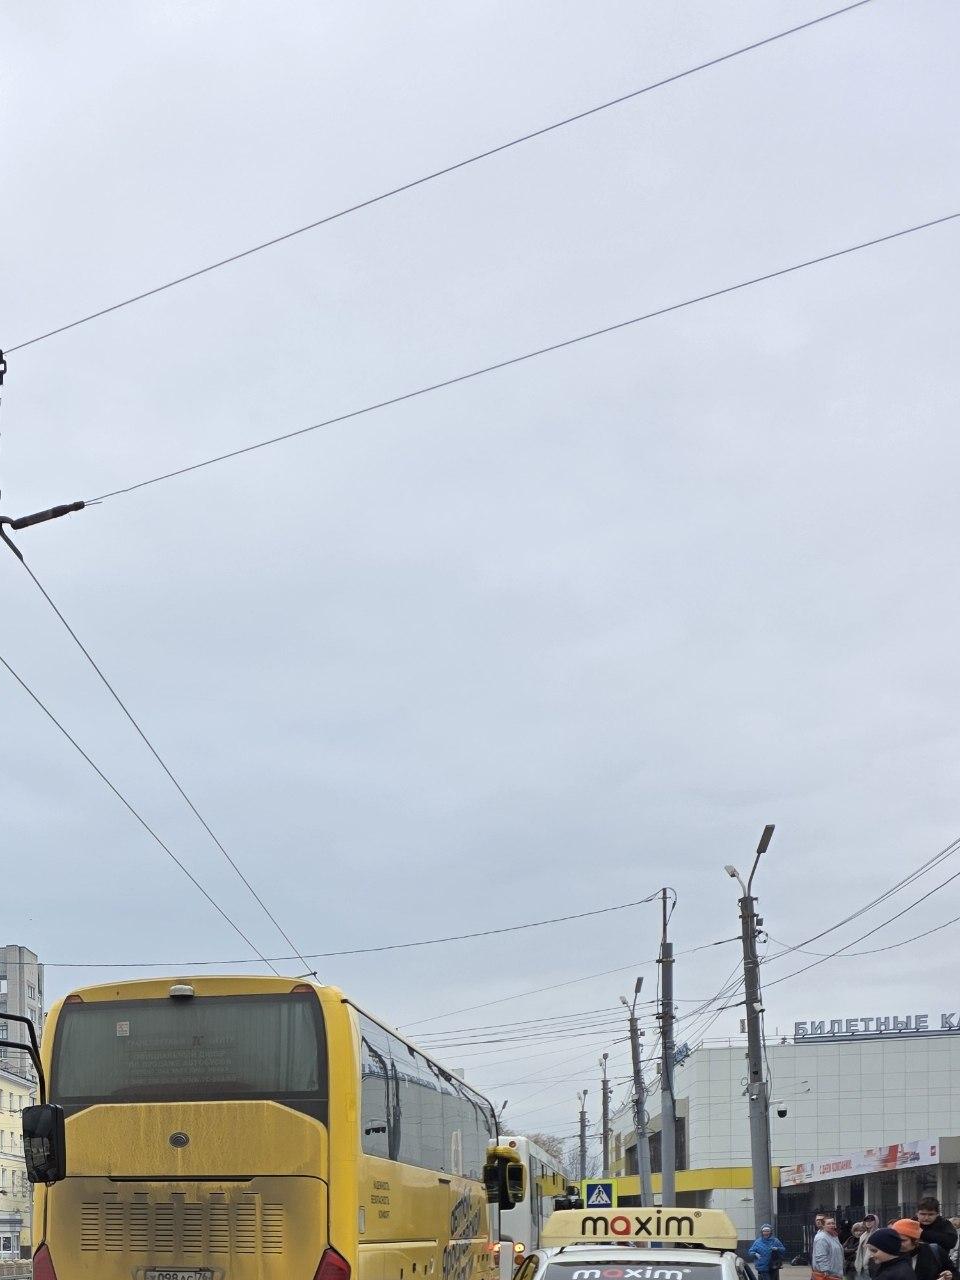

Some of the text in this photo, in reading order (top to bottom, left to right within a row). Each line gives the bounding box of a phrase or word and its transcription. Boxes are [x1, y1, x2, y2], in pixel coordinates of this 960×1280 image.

[794, 1012, 960, 1036] БИЛЕТНЫЕ К
[581, 1210, 695, 1237] maxim
[572, 1266, 683, 1280] maxim
